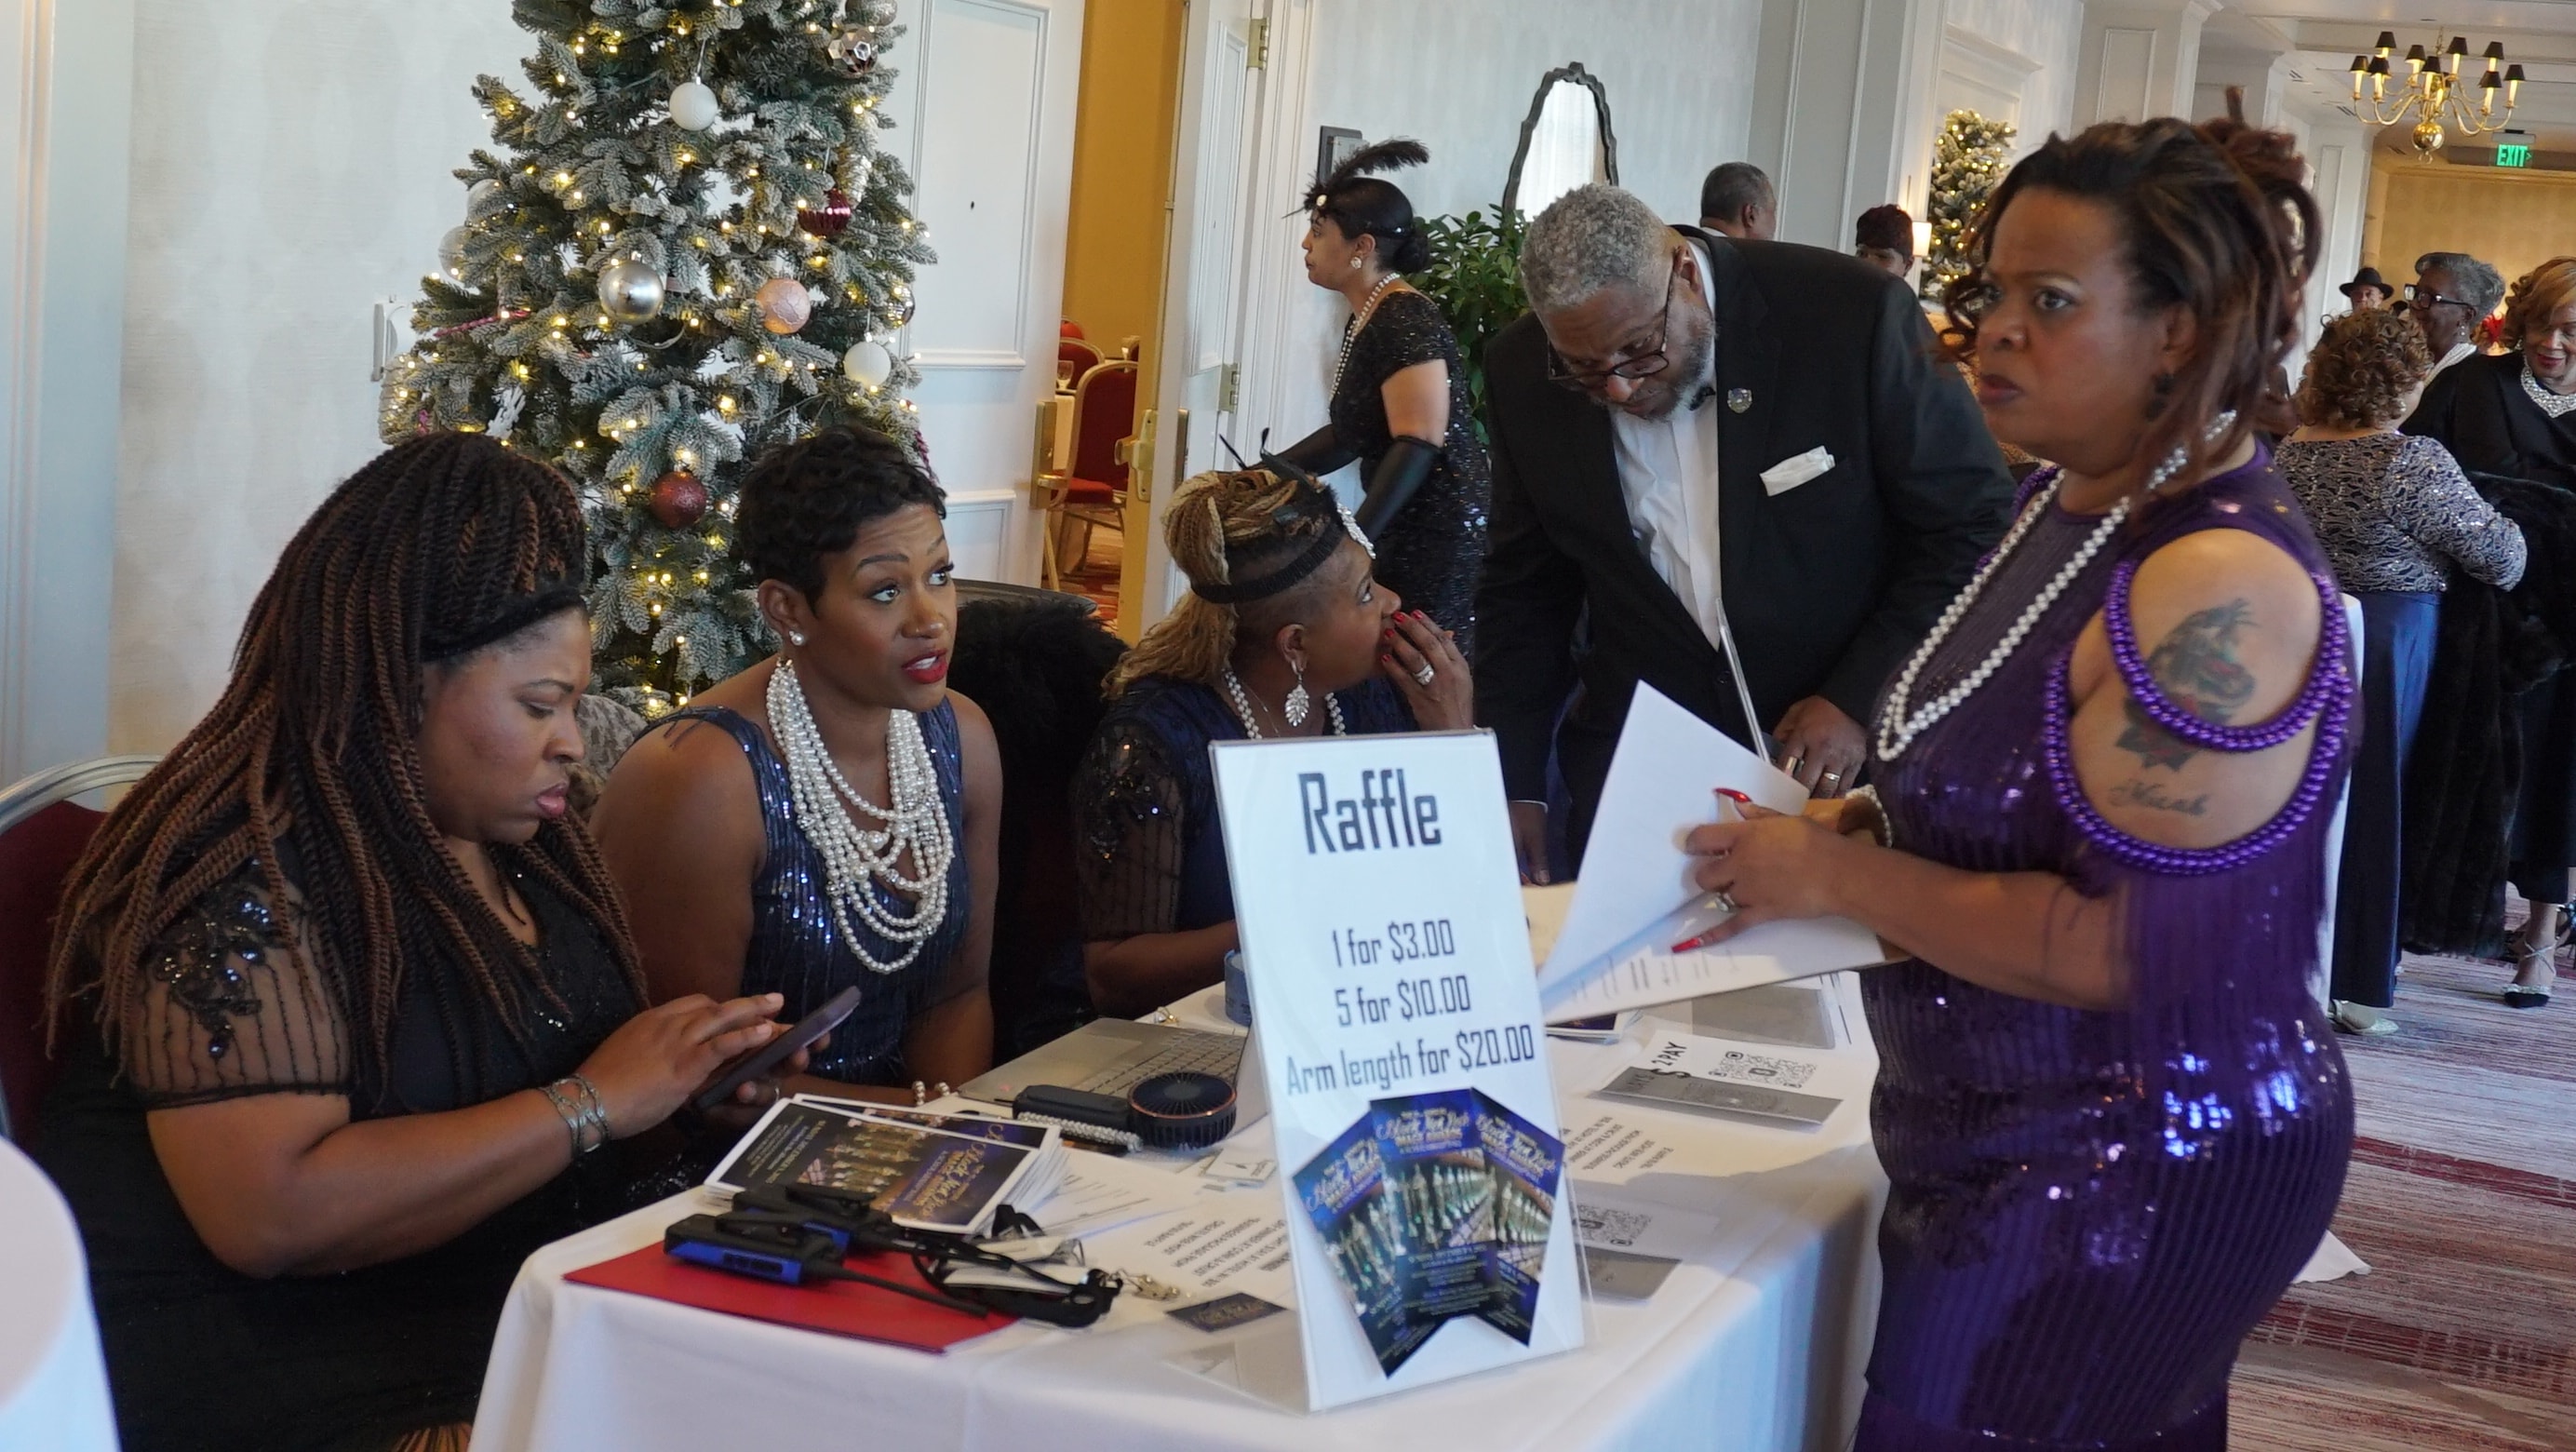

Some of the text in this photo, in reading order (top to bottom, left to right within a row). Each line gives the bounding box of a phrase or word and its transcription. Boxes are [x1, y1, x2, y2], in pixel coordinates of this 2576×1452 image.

[2496, 144, 2529, 168] EXIT
[1298, 769, 1442, 854] Raffle
[1332, 919, 1456, 968] 1 for $3.00
[1335, 975, 1471, 1028] 5 for $10.00
[1287, 1024, 1535, 1096] Arm length for $20.00
